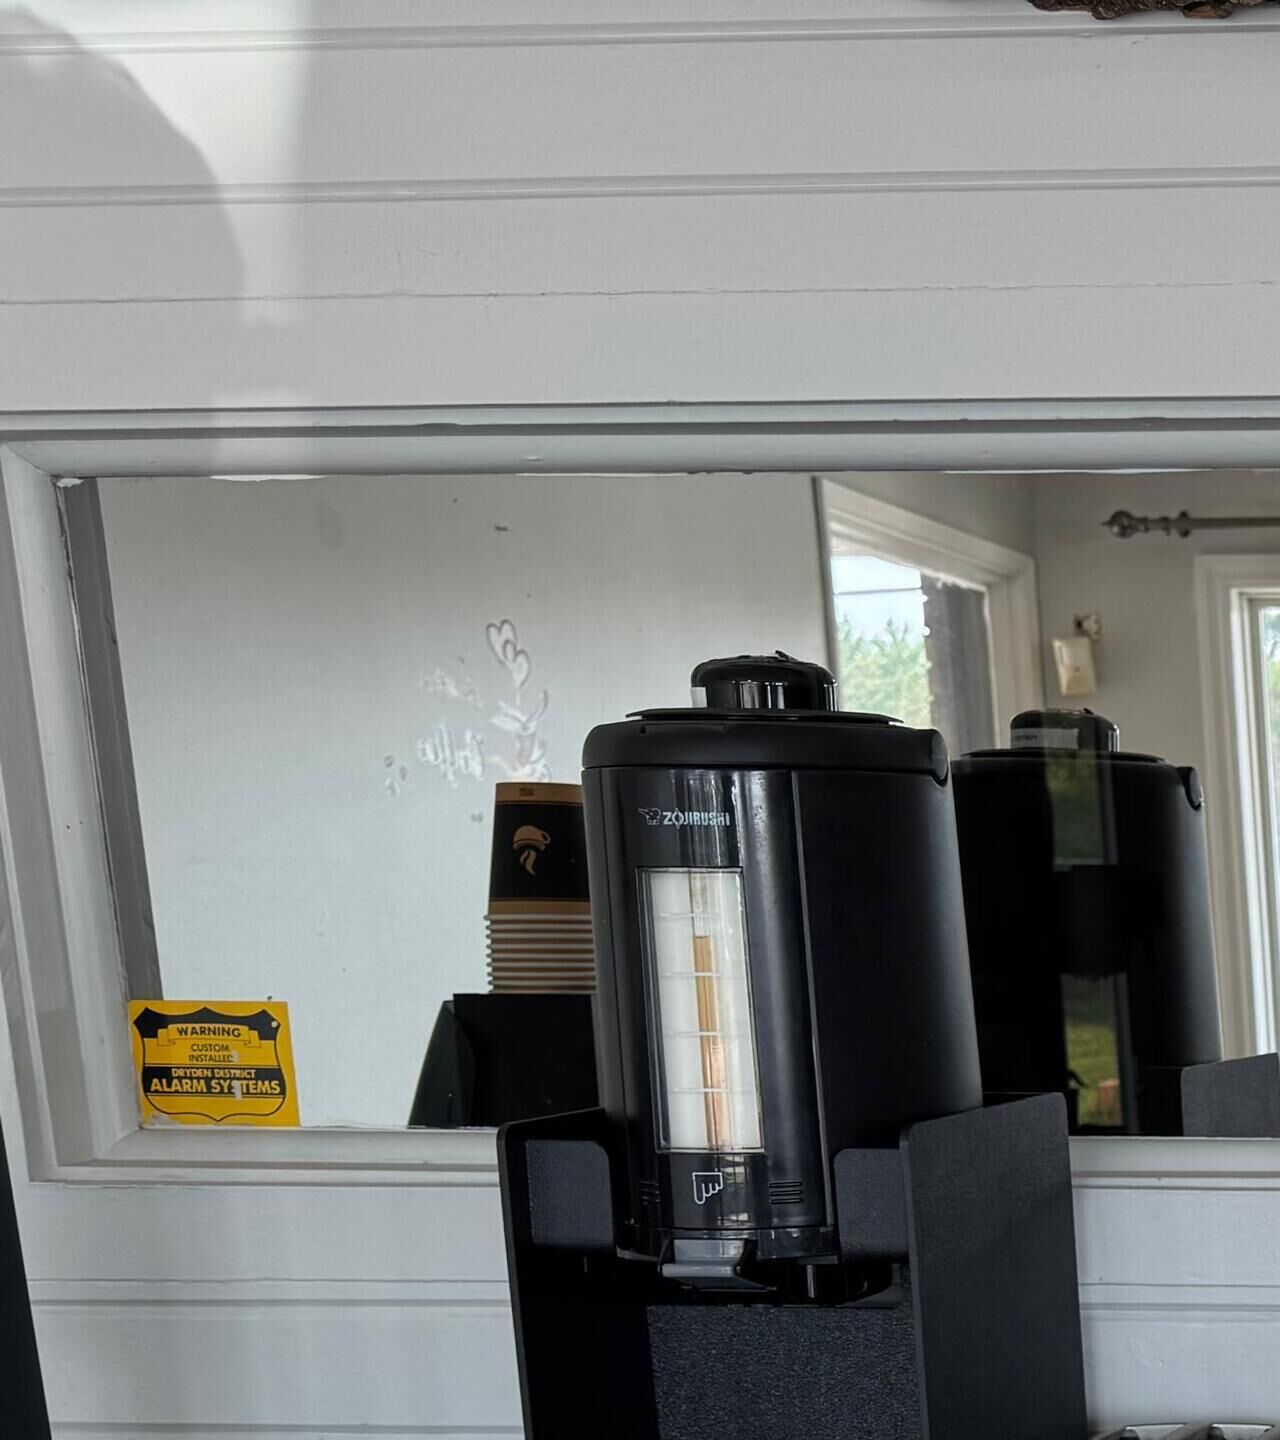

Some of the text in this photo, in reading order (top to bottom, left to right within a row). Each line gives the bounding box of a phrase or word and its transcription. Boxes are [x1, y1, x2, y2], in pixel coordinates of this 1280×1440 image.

[662, 809, 731, 828] ZOJIRUSHI
[176, 1027, 241, 1038] WARNING
[191, 1043, 231, 1052] CUSTOM
[172, 1067, 256, 1079] DRYDEN DISTRICT
[150, 1078, 208, 1093] ALARM
